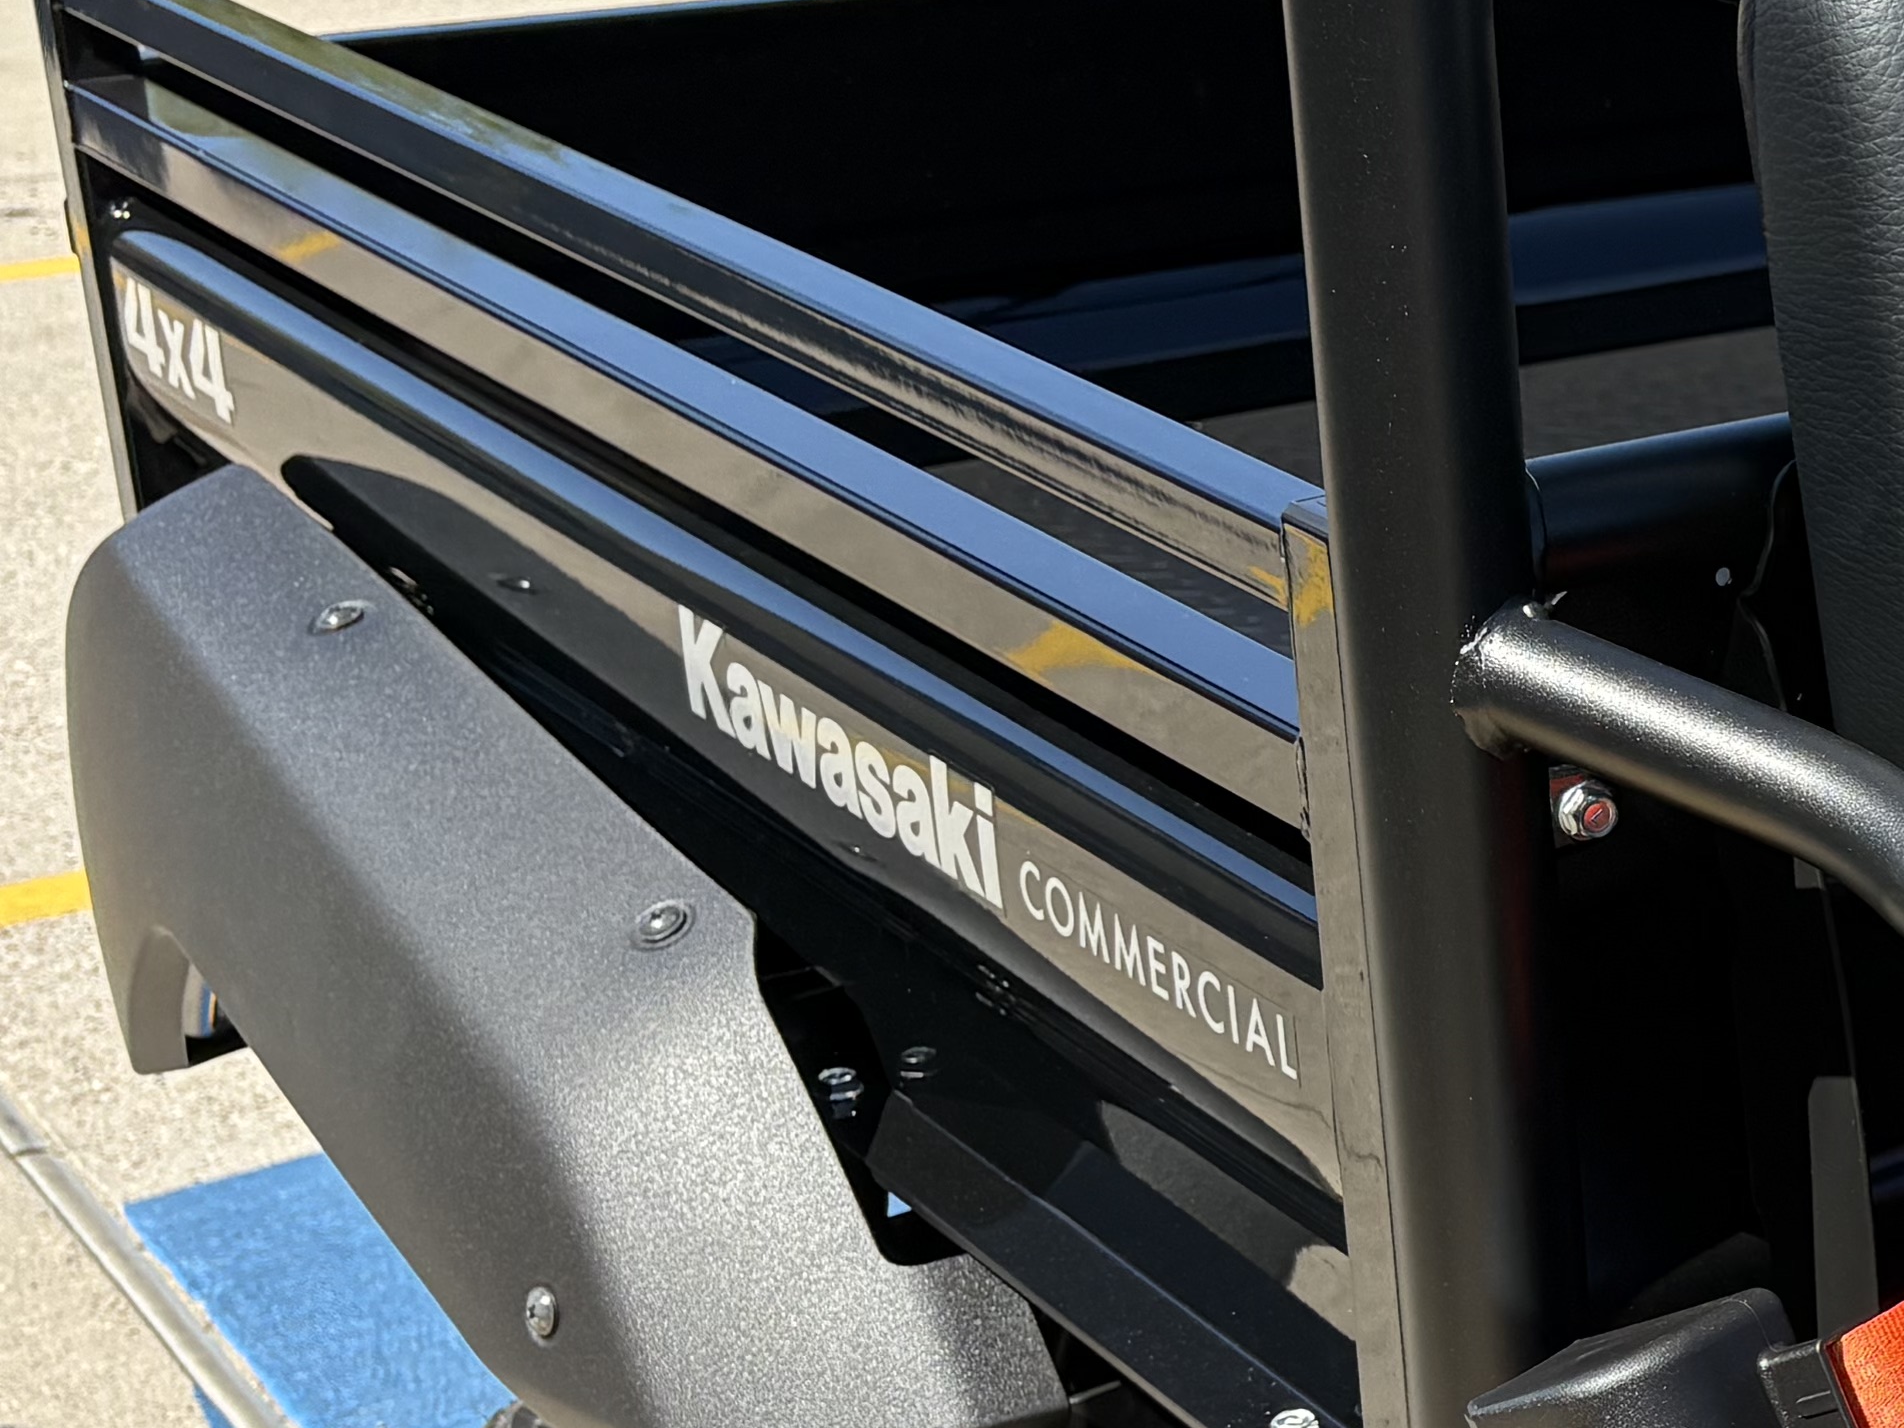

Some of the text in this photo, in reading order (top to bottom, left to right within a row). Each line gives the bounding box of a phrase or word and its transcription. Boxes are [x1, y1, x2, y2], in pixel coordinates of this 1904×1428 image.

[123, 276, 236, 425] 4x4
[677, 603, 1299, 1081] Kawasaki COMMERCIAL
